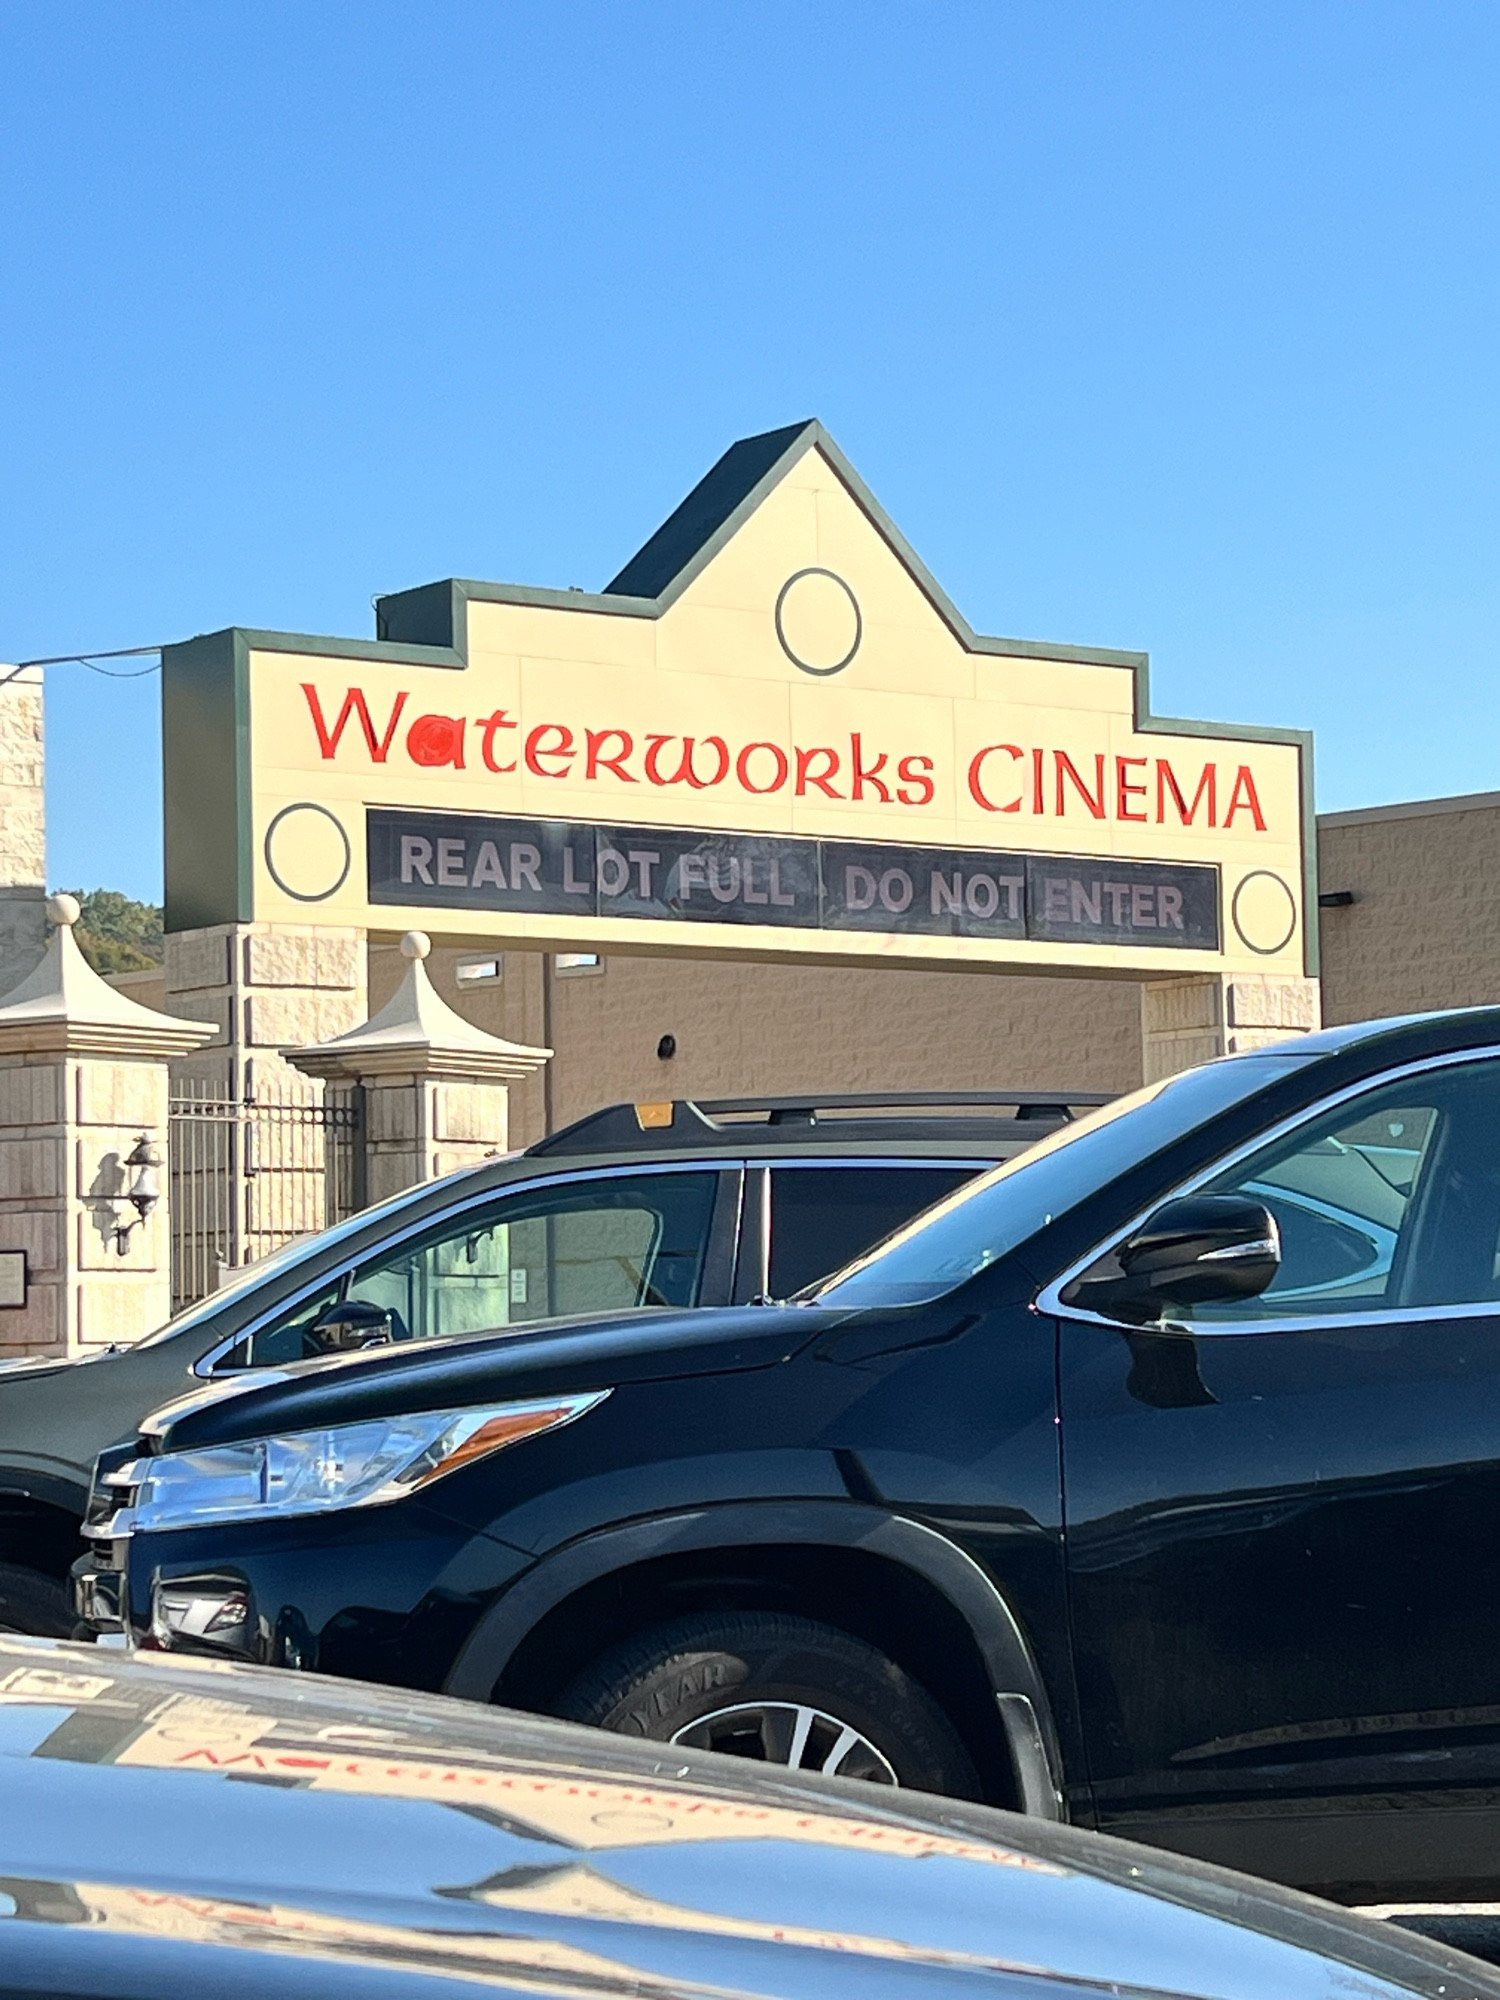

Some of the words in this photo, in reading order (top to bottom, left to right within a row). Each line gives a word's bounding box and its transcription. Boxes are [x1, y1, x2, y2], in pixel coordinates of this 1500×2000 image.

[300, 682, 934, 805] Waterworks
[968, 744, 1267, 831] CINEMA
[400, 835, 542, 892] REAR
[563, 847, 660, 897] LOT
[680, 853, 795, 906] FULL
[845, 865, 913, 913] DO
[930, 870, 1025, 919] NOT
[1044, 877, 1184, 930] ENTER
